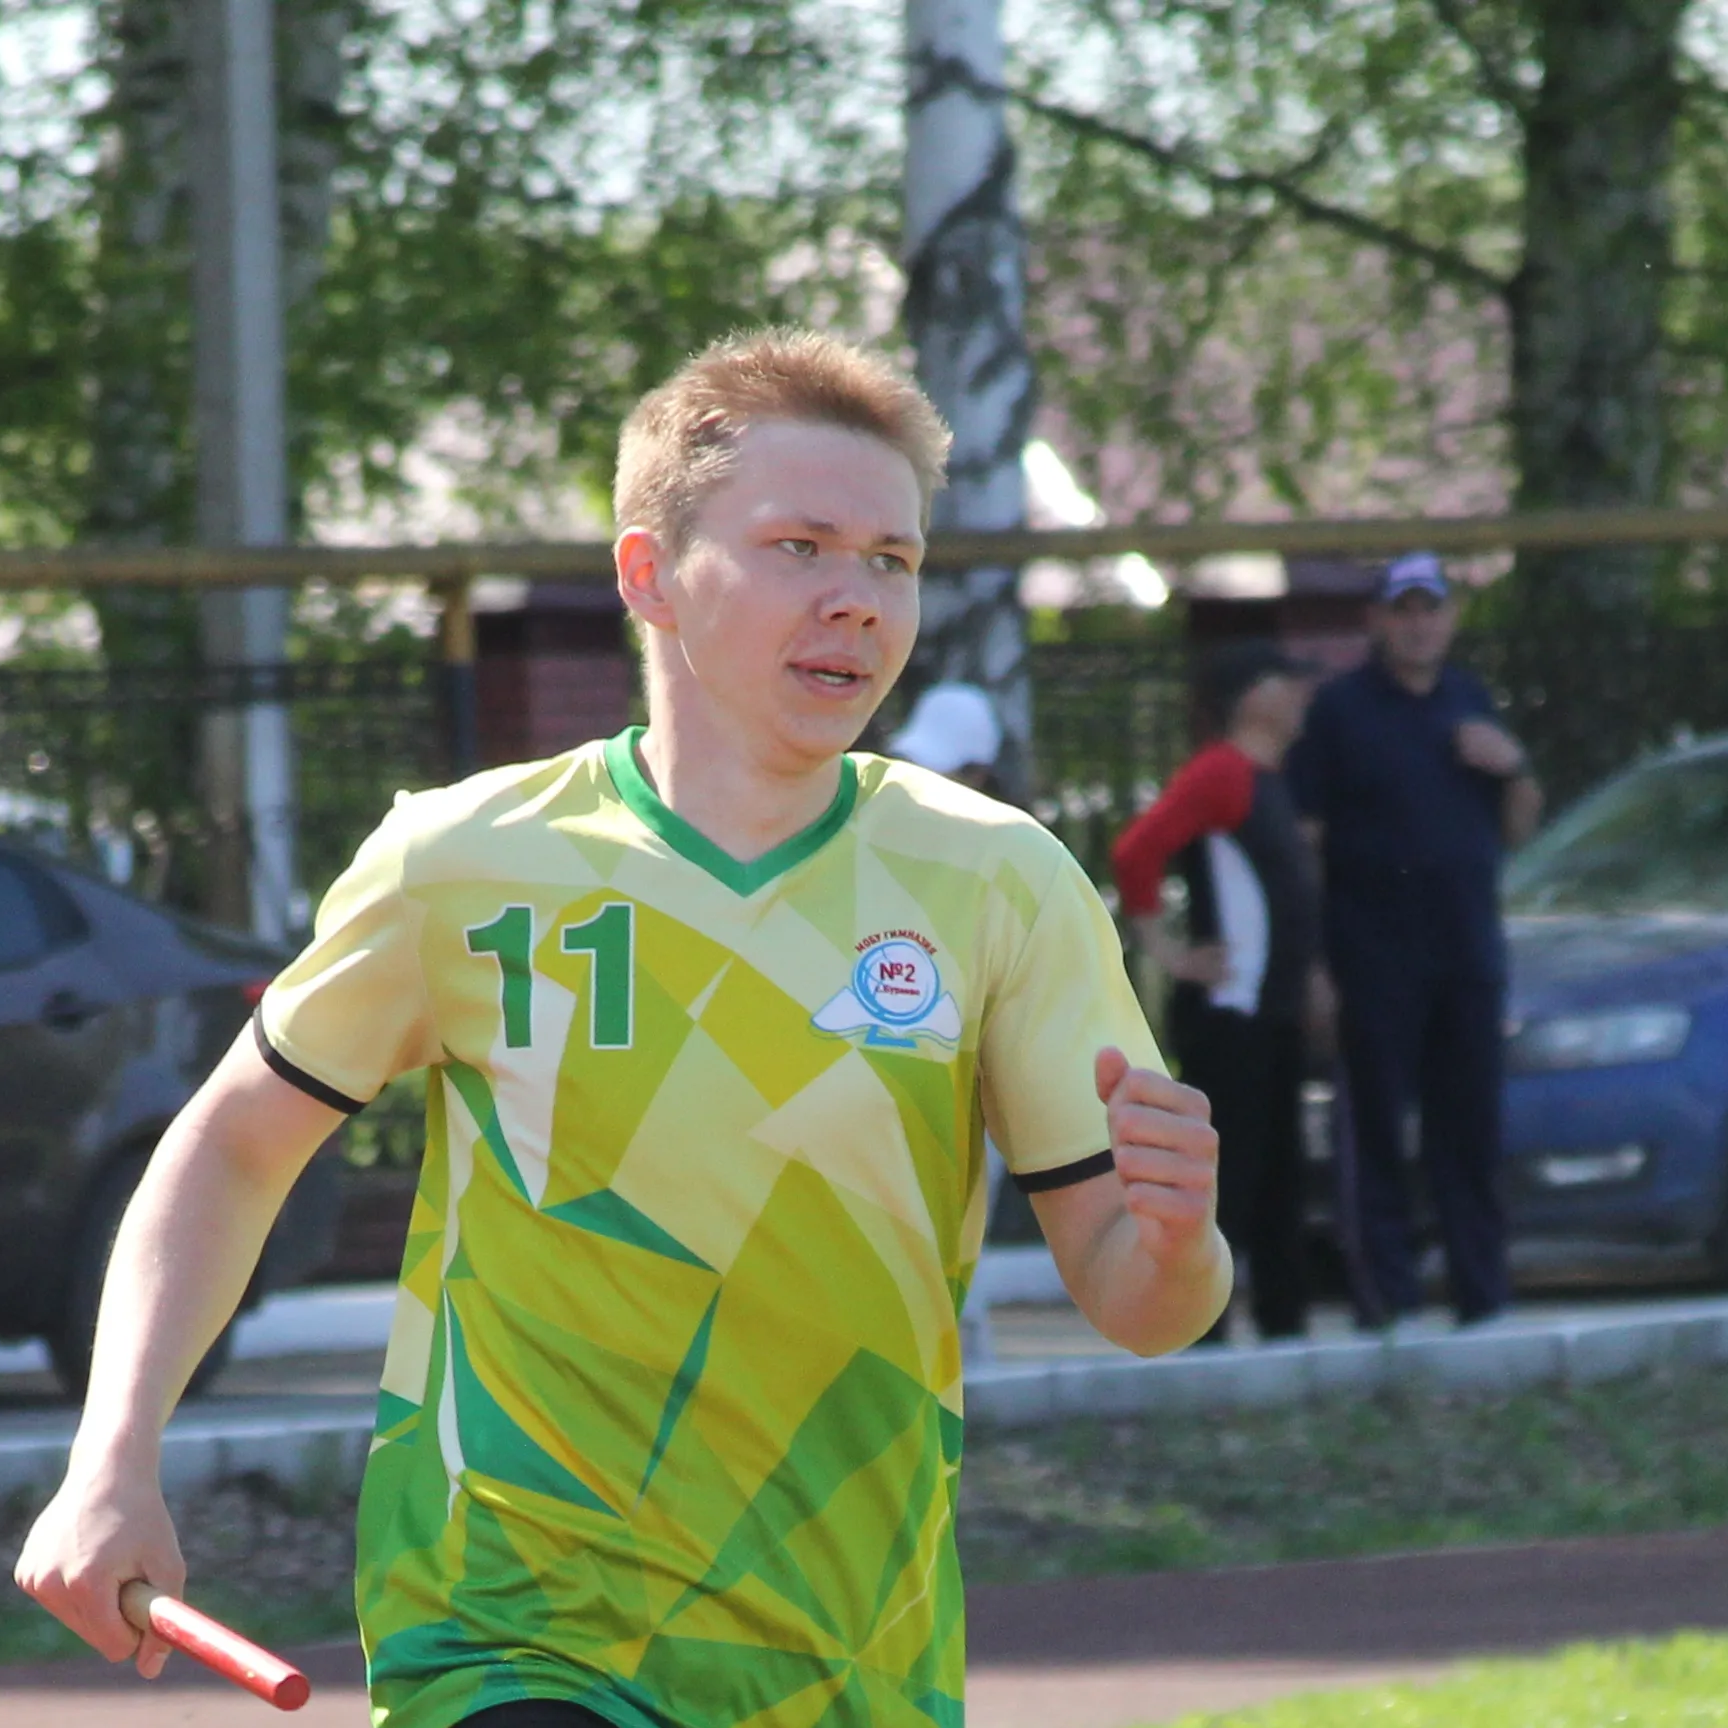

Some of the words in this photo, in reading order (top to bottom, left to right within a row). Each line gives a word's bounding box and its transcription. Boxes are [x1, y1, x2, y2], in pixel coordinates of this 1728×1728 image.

[855, 933, 880, 953] МОБУ
[884, 930, 937, 955] ГИМНАЗИЯ
[463, 903, 634, 1049] 11
[879, 962, 916, 983] №2
